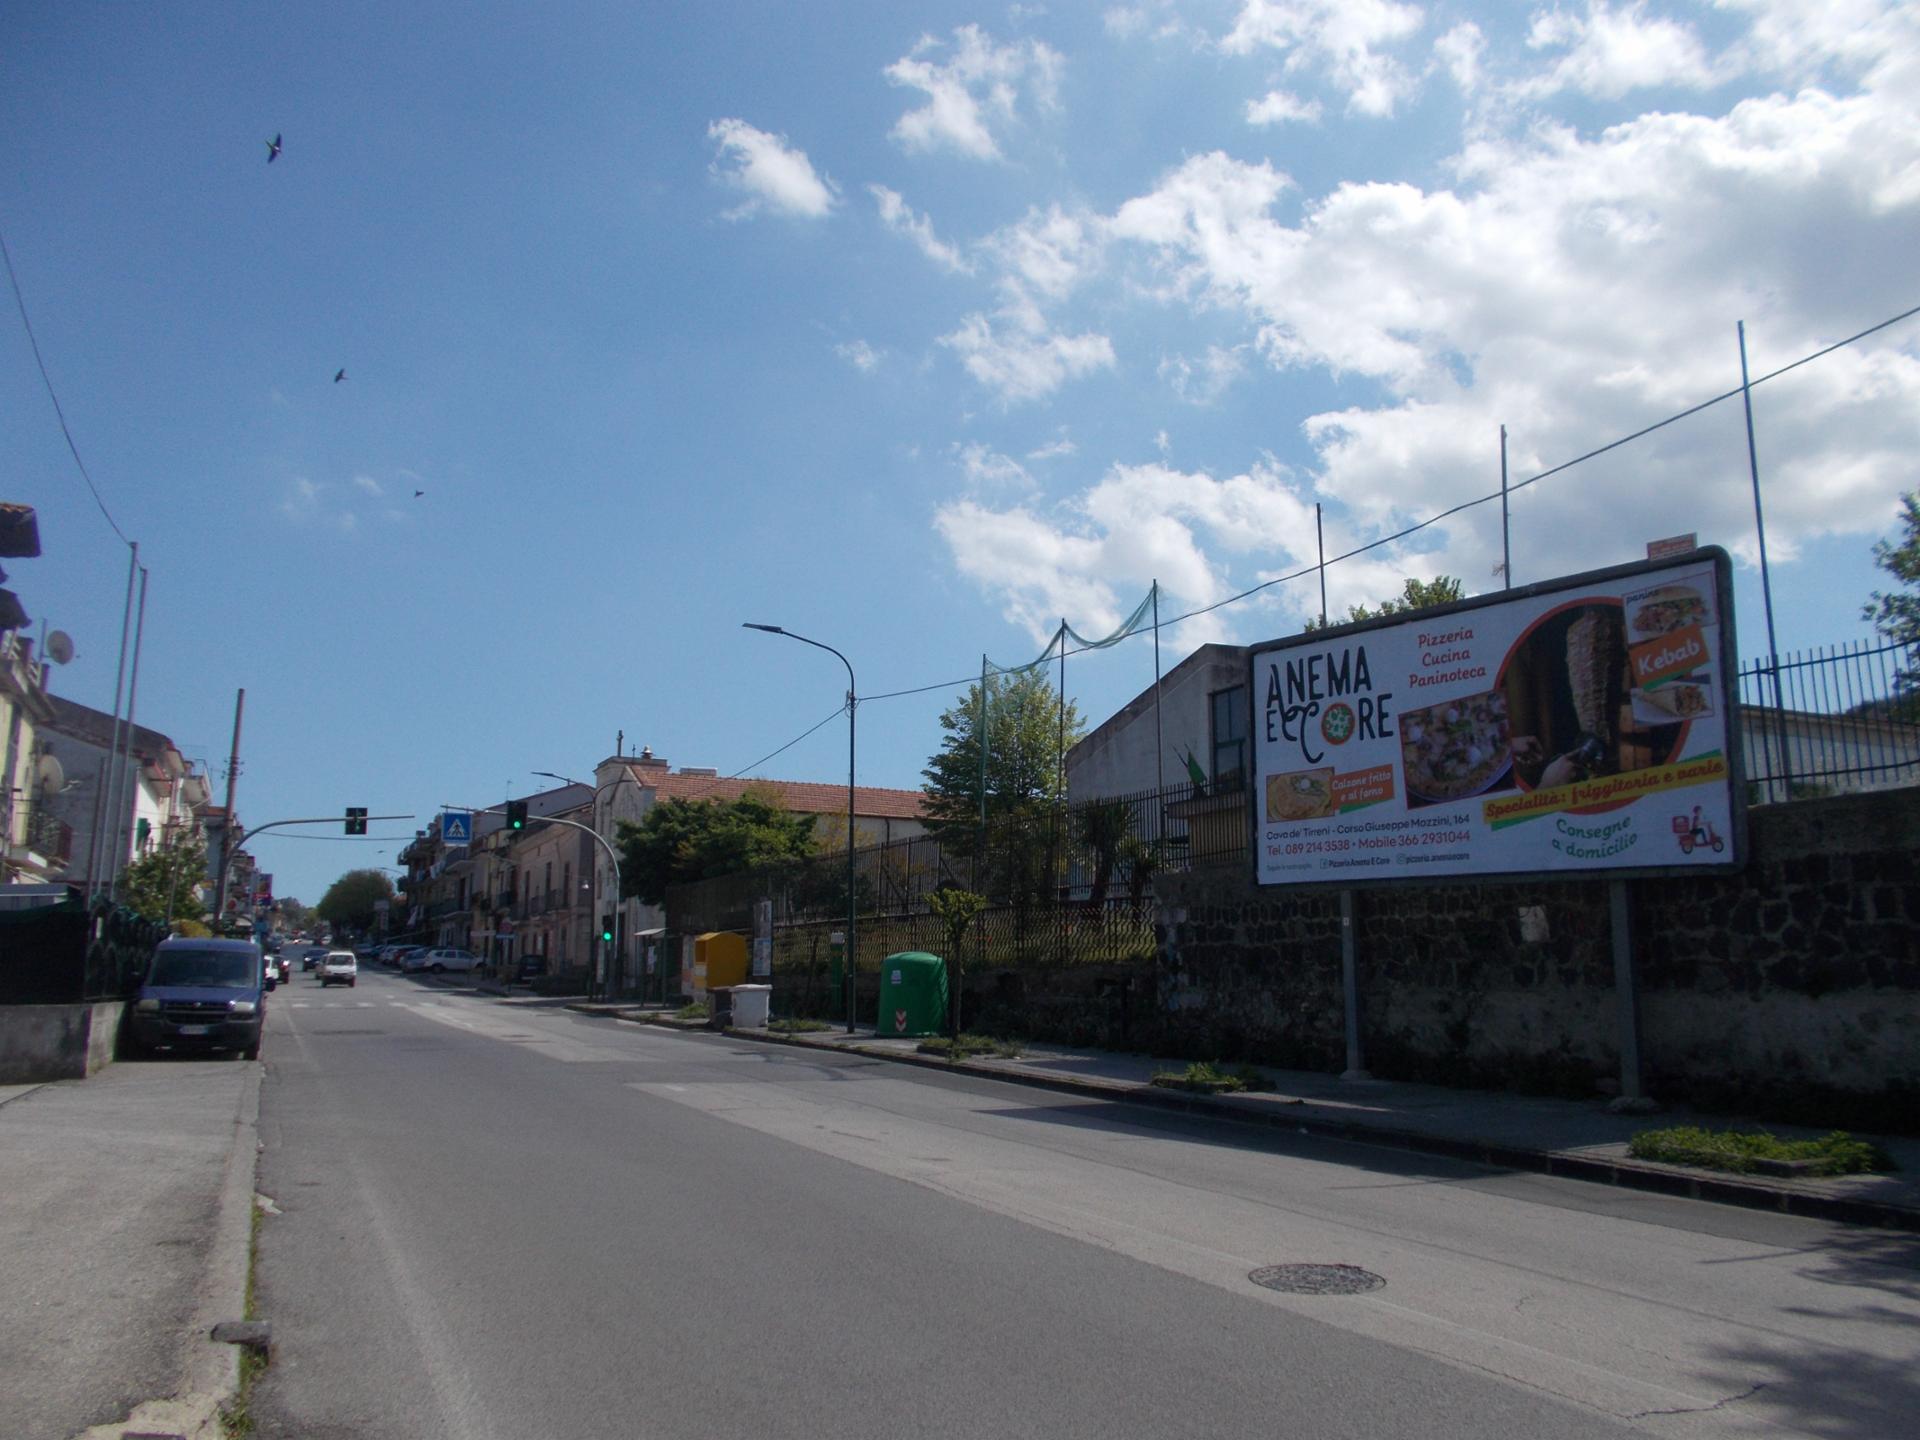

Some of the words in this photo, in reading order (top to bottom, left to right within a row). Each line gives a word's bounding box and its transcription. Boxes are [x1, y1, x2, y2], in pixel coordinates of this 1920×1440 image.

[1418, 627, 1474, 648] Pizzeria
[1422, 649, 1471, 667] Cucina
[1638, 638, 1700, 675] Kebab
[1266, 646, 1372, 708] ANEMA
[1409, 665, 1487, 688] Paninoteca
[1331, 777, 1367, 790] Calzone
[1368, 771, 1392, 785] fritto
[1359, 787, 1384, 800] forno
[1486, 791, 1567, 818] Specialità:
[1571, 773, 1660, 804] friggitoria
[1663, 771, 1674, 782] e
[1303, 827, 1330, 837] Tirreni
[1337, 824, 1364, 835] Corso
[1365, 821, 1410, 833] Giuseppe
[1454, 814, 1470, 825] 164
[1556, 816, 1632, 842] Consegne
[1267, 845, 1284, 857] Tel.
[1285, 842, 1303, 855] 089
[1306, 841, 1323, 854] 214
[1324, 839, 1350, 853] 3538
[1358, 836, 1397, 850] Mobile
[1398, 834, 1419, 847] 366
[1422, 831, 1470, 845] 2931044
[1552, 839, 1562, 850] a
[1566, 833, 1638, 859] domicilio
